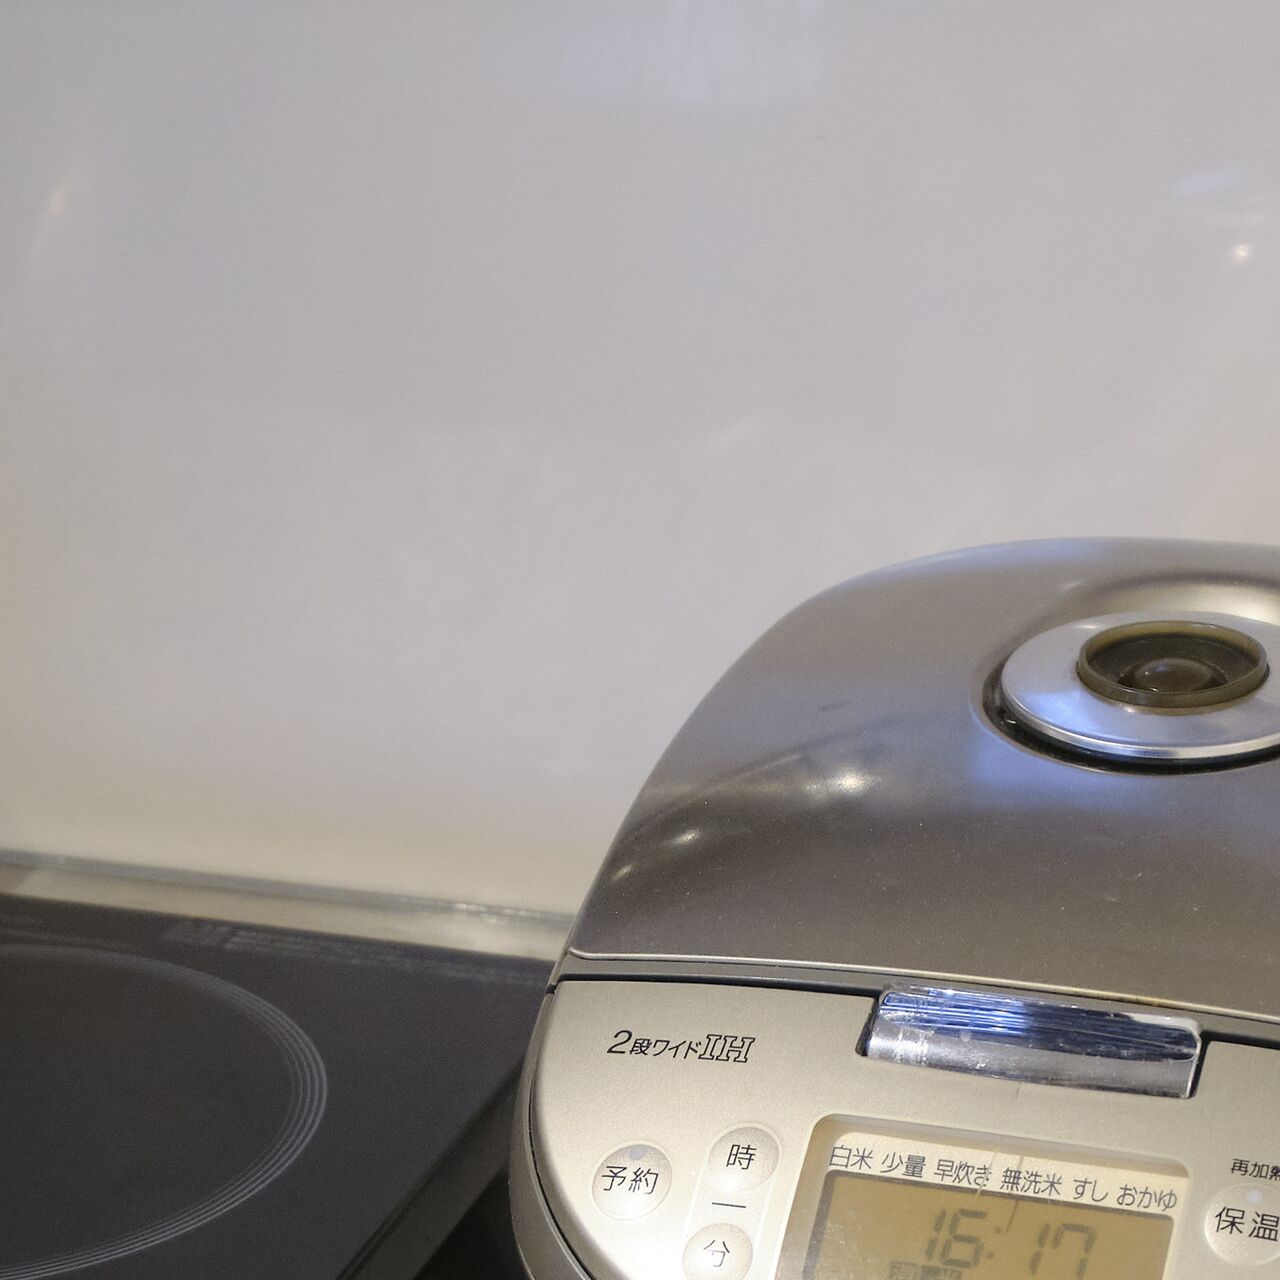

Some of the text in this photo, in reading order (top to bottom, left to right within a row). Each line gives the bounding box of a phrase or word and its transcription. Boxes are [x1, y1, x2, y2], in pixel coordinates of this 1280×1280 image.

[725, 1143, 757, 1171] 時
[601, 1165, 660, 1195] 予約
[829, 1145, 1177, 1212] 白米 少量 早炊き 無洗米 すし おかゆ
[1215, 1205, 1280, 1242] 保温
[703, 1239, 731, 1268] 分
